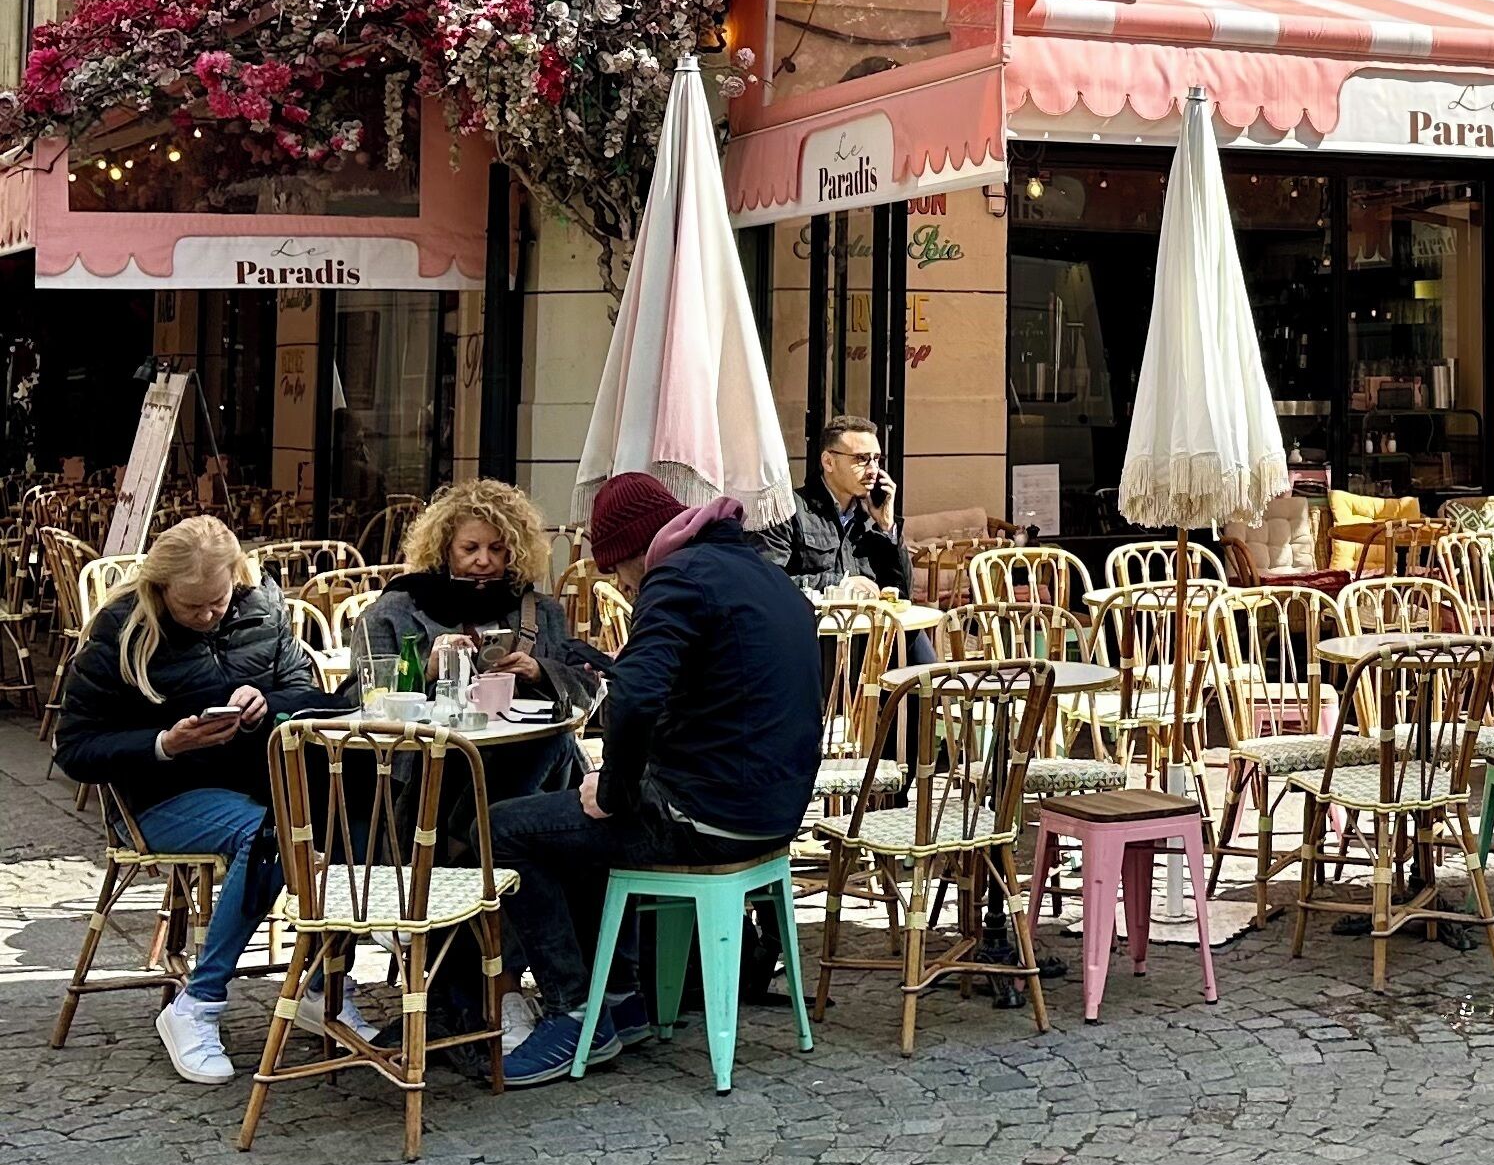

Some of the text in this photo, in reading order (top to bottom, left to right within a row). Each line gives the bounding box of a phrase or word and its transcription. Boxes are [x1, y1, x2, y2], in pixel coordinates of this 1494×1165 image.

[833, 132, 864, 161] Le
[817, 156, 878, 202] Paradis
[270, 238, 328, 257] Le
[235, 259, 361, 286] Paradis
